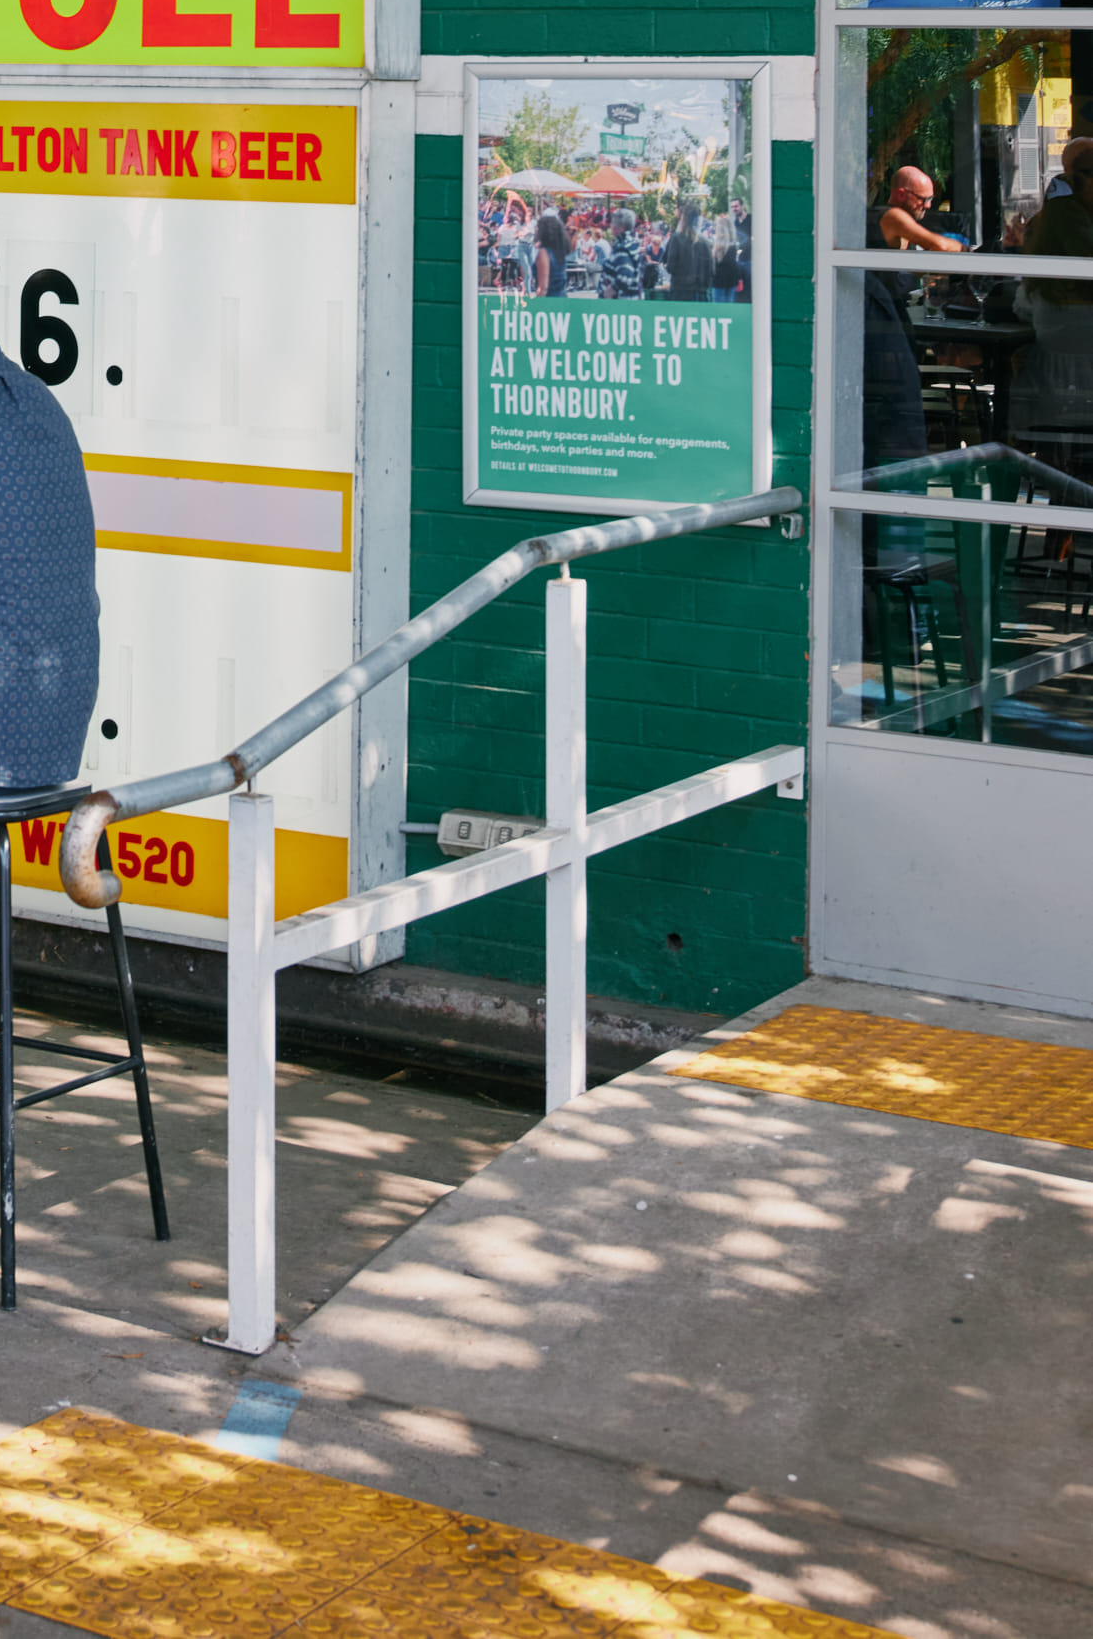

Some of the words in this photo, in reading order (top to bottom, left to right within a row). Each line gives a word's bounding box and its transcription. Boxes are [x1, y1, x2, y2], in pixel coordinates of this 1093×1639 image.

[100, 128, 200, 178] TANK
[211, 131, 323, 182] BEER
[490, 309, 571, 344] THROW
[582, 313, 643, 346] YOUR
[654, 316, 732, 350] EVENT
[490, 346, 517, 378] AT
[528, 348, 641, 384] WELCOME
[652, 353, 682, 386] TO
[490, 383, 635, 422] THORNBURY.
[491, 425, 524, 437] Private
[526, 429, 552, 442] party
[554, 431, 589, 442] spaces
[590, 432, 636, 444] available
[638, 434, 654, 445] for
[655, 437, 730, 450] engagements,
[491, 439, 539, 454] birthdays,
[541, 443, 566, 454] work
[568, 445, 603, 457] parties
[605, 447, 625, 458] and
[627, 449, 657, 459] more.
[518, 462, 526, 471] AT
